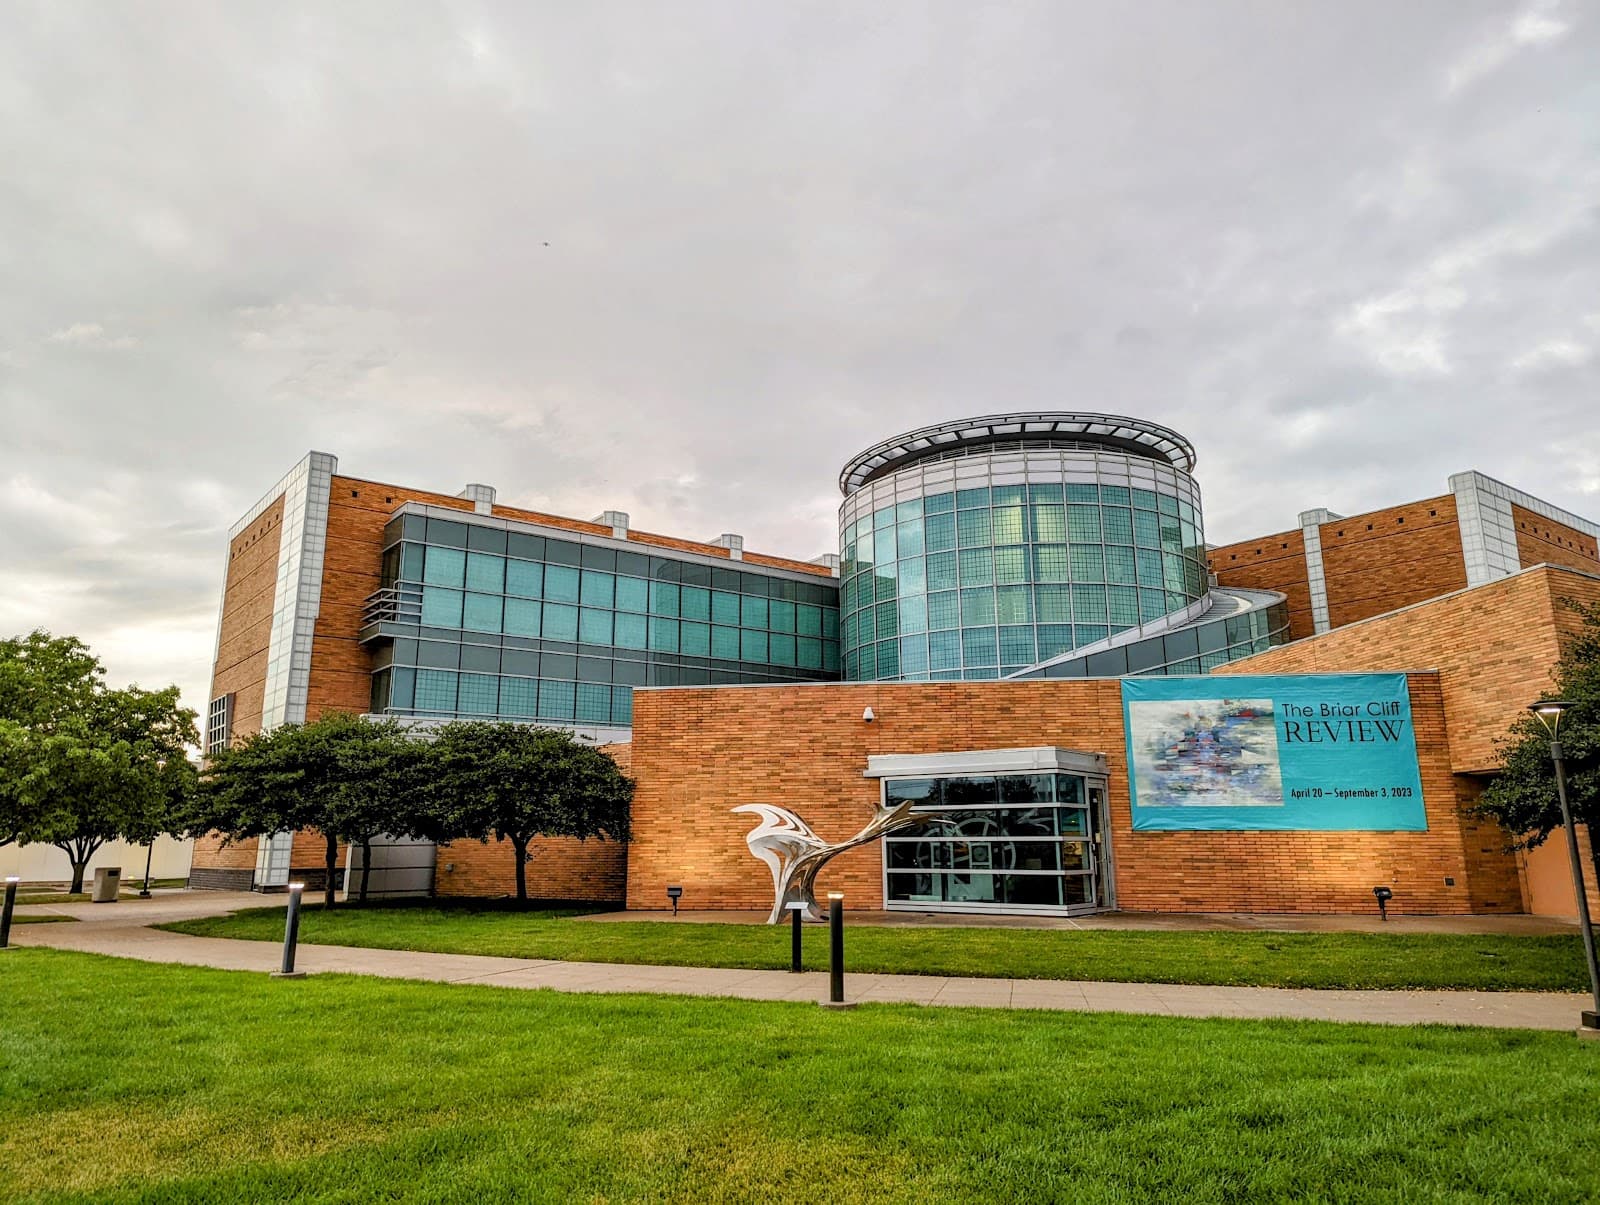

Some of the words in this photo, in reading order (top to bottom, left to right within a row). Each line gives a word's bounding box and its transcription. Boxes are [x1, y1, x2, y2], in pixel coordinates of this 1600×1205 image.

[1283, 703, 1313, 717] The
[1320, 702, 1360, 717] Briar
[1367, 701, 1401, 716] Cliff
[1285, 720, 1405, 743] REVIEW
[1291, 787, 1311, 799] April
[1312, 788, 1323, 798] 20
[1335, 787, 1379, 800] September
[1381, 788, 1390, 799] 3,
[1391, 787, 1412, 798] 2023
